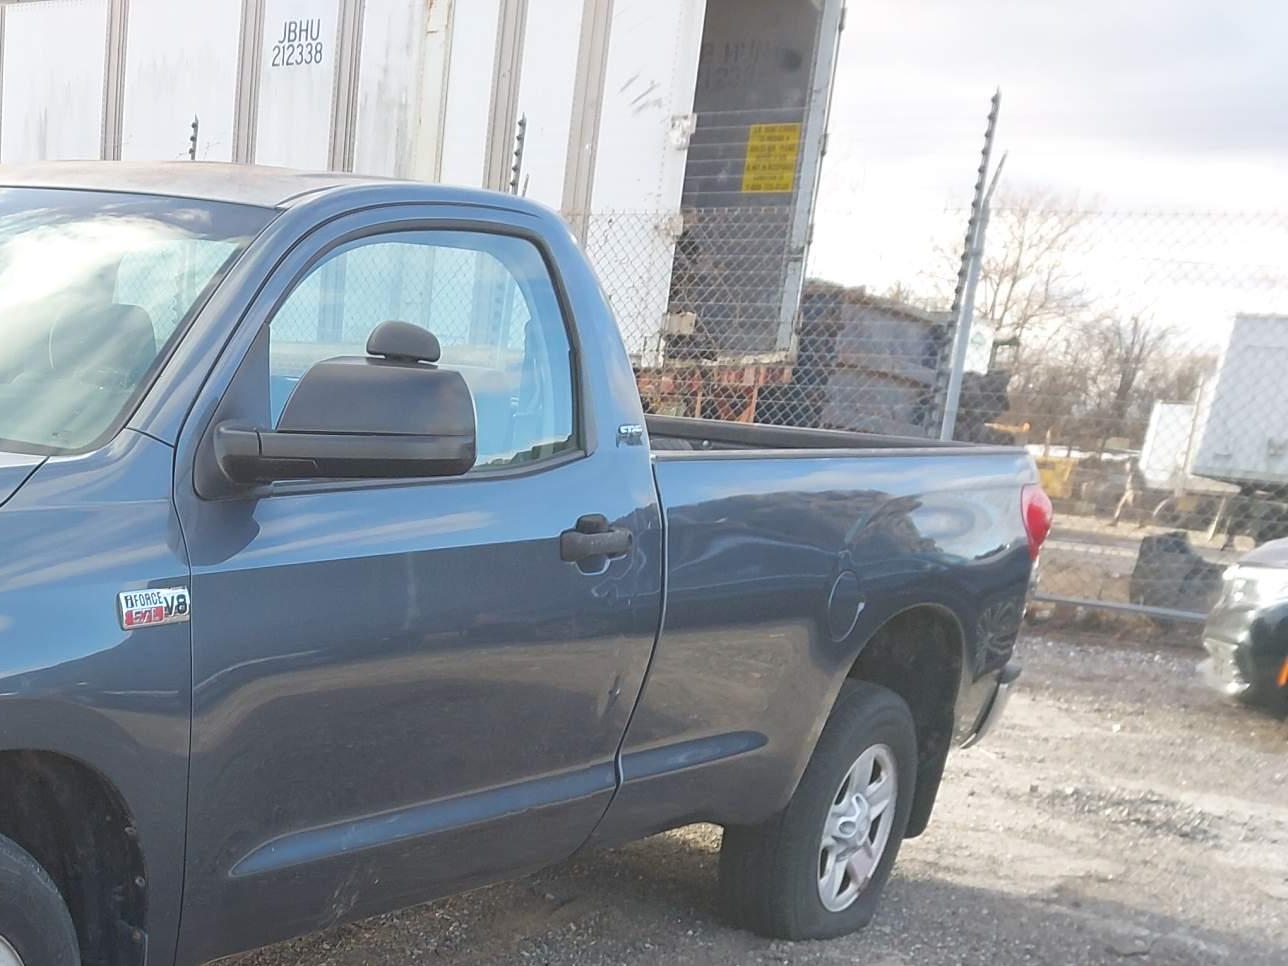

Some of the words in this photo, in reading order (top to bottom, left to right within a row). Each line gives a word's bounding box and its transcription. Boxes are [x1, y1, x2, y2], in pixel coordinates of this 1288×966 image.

[278, 18, 321, 44] JBHU
[272, 41, 323, 67] 212338
[164, 593, 189, 616] V8
